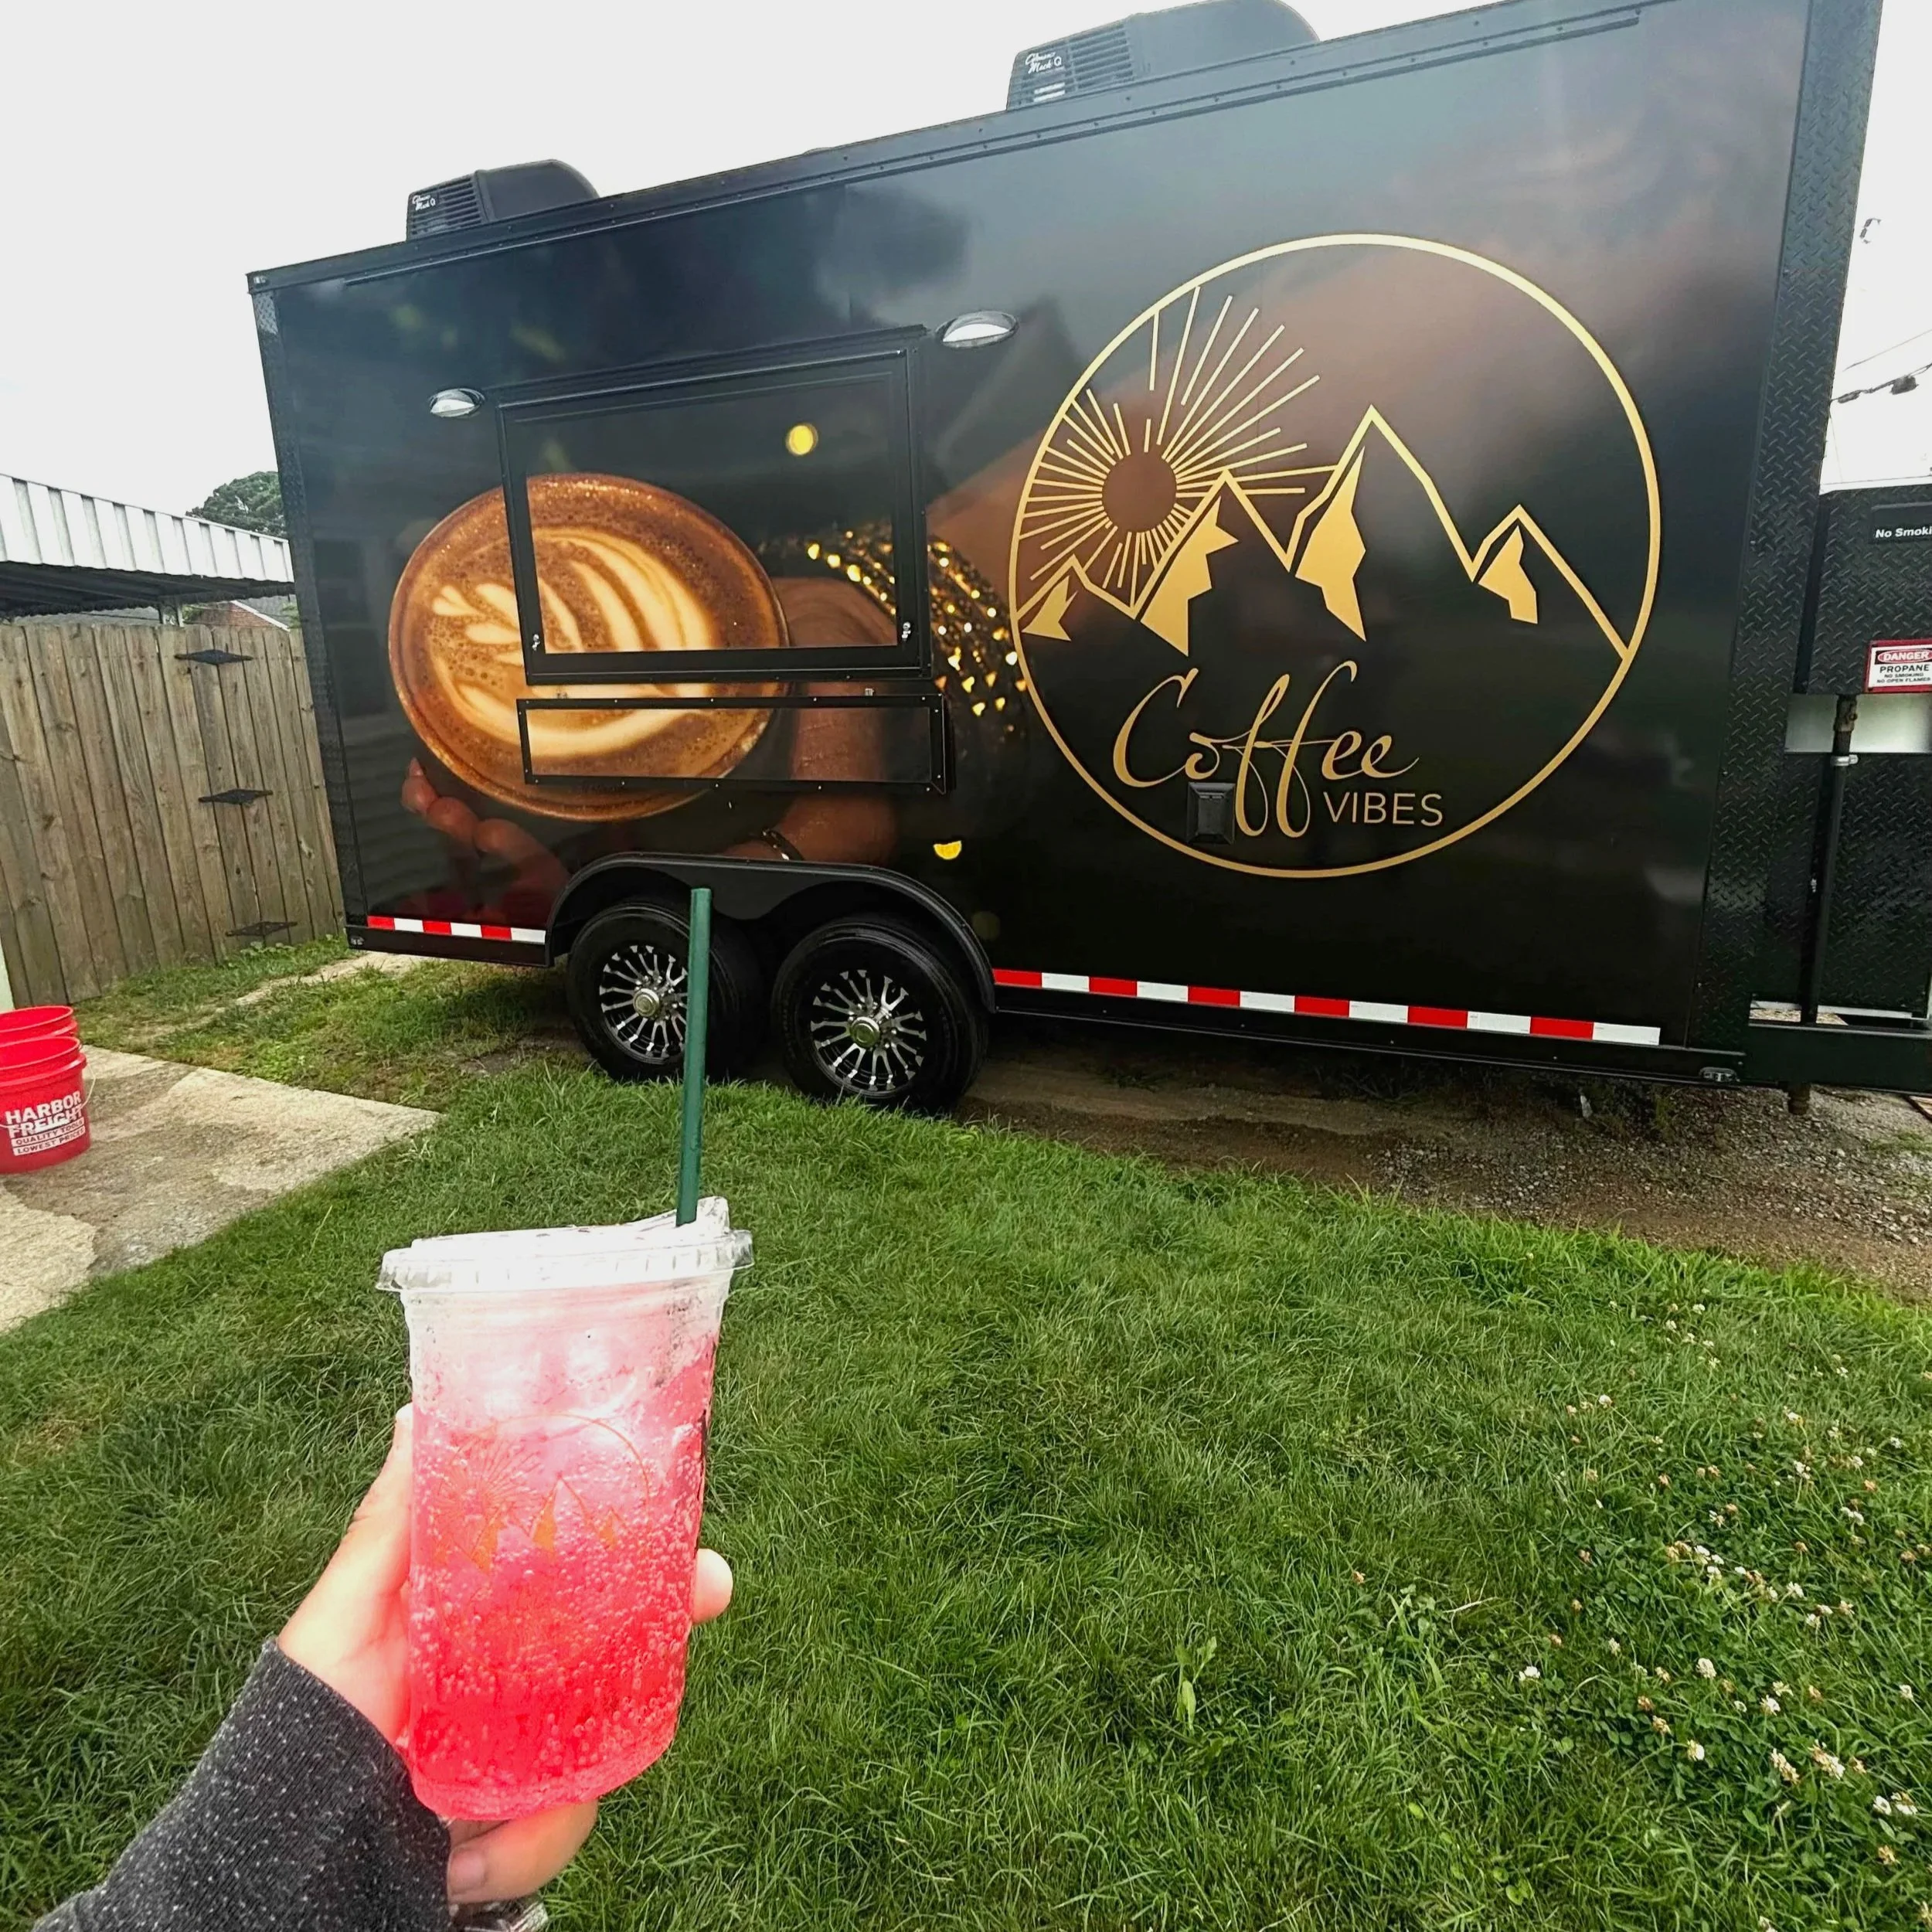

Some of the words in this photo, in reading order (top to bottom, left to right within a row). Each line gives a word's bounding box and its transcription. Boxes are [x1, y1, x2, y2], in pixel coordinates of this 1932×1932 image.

[1875, 529, 1892, 538] No
[1879, 664, 1930, 673] PROPANE
[1883, 651, 1930, 662] DANGER
[1113, 660, 1419, 838] Coffee
[1323, 791, 1444, 827] VIBES
[5, 1090, 82, 1125] HARBOR
[8, 1104, 83, 1139] FREIGHT
[15, 1130, 59, 1145] QUALITY
[61, 1119, 83, 1134] TOOLS
[17, 1139, 57, 1154] LOWEST
[59, 1128, 84, 1144] PRICES
